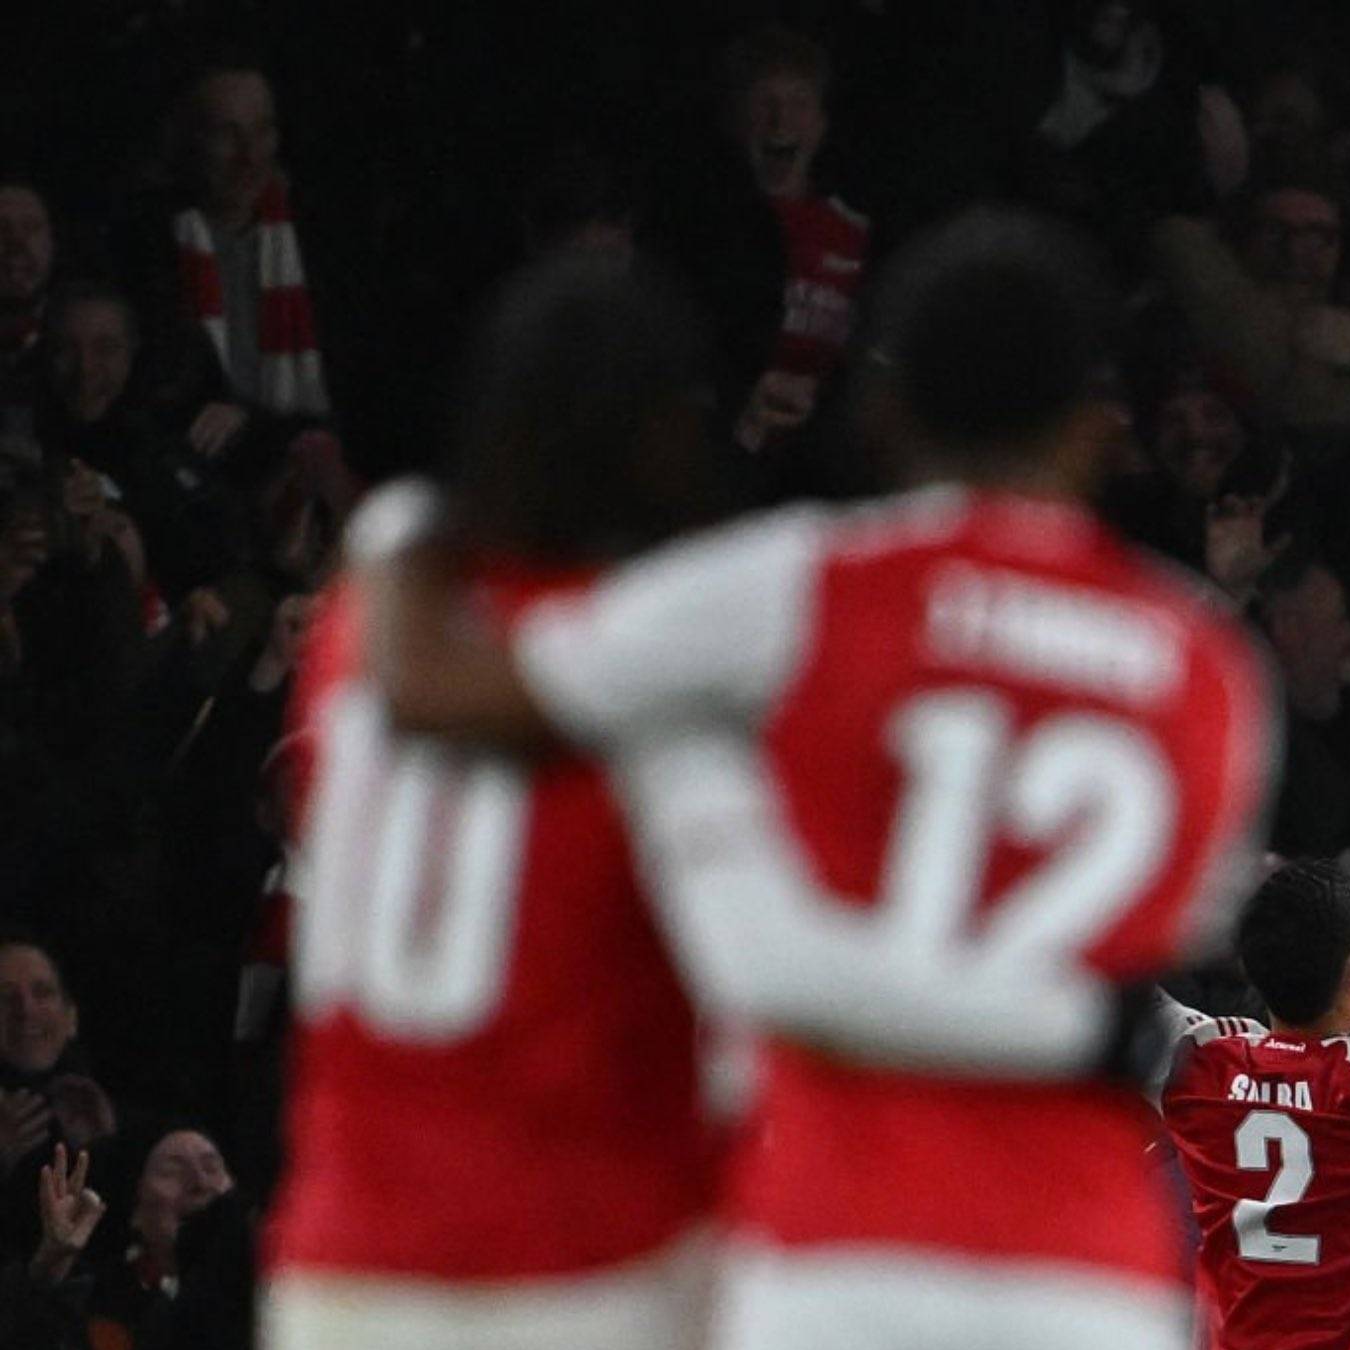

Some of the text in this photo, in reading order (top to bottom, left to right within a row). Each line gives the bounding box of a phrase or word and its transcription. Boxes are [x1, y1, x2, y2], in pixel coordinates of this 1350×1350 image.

[297, 688, 531, 1045] 10
[884, 690, 1182, 975] 12
[1233, 1109, 1322, 1265] 2
